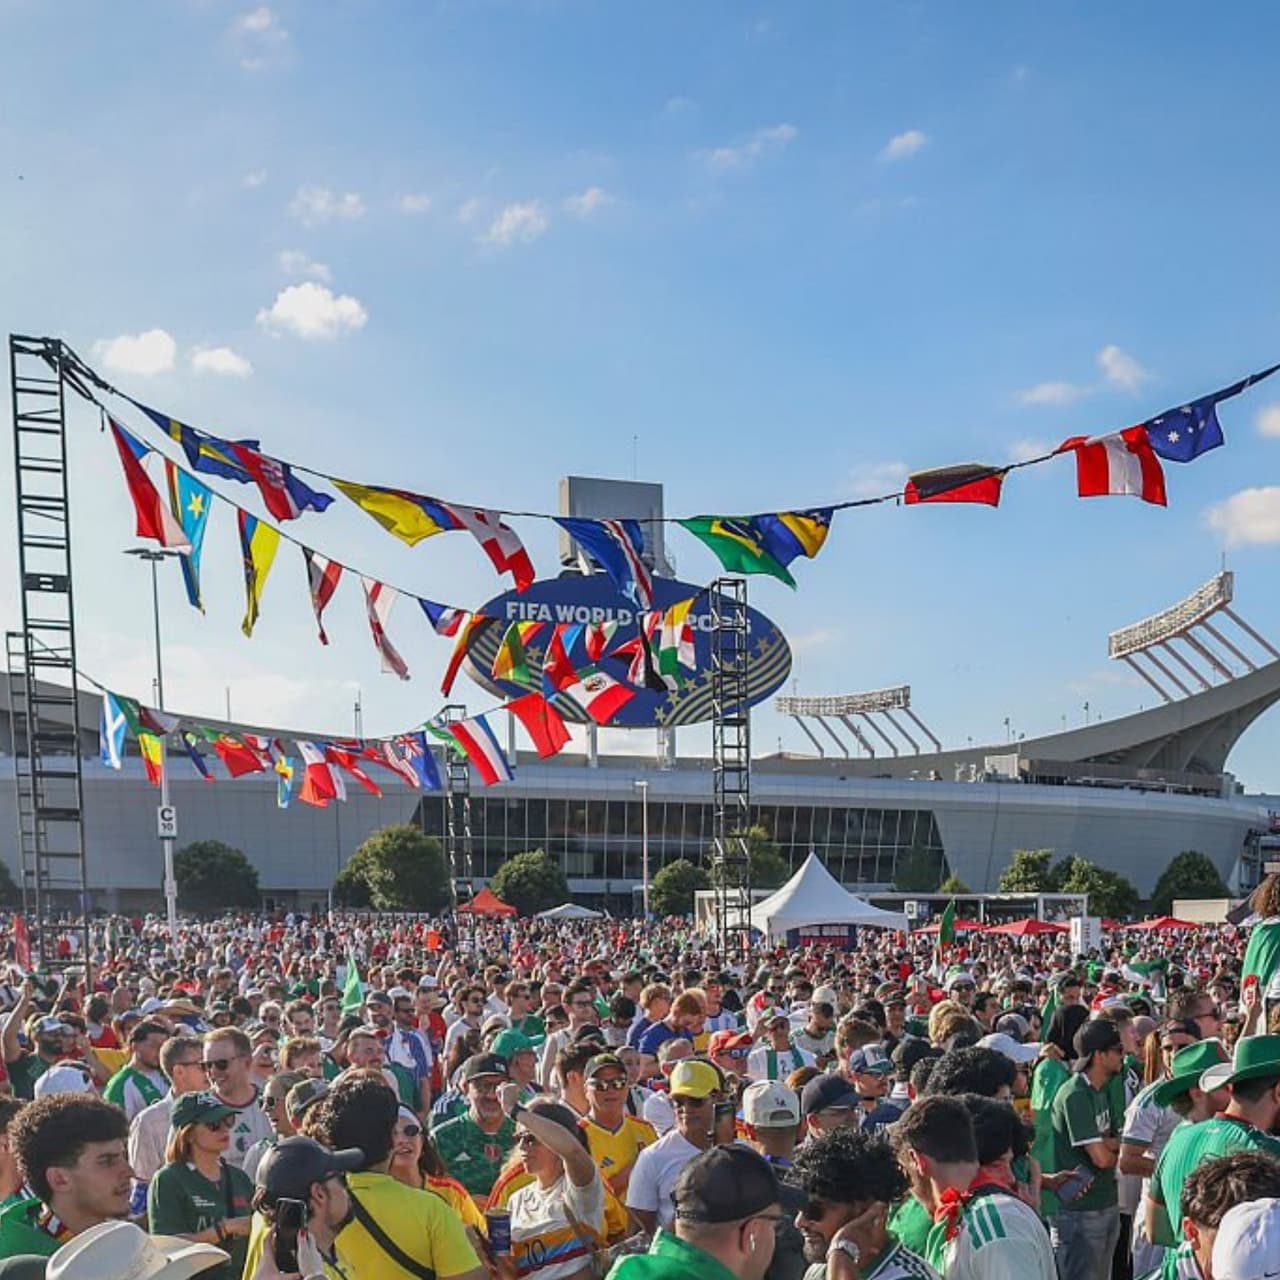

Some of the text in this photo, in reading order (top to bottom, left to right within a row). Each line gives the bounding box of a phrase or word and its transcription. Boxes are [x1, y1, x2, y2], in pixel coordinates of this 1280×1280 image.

[506, 601, 553, 622] FIFA
[556, 604, 632, 625] WORLD
[161, 808, 173, 821] C
